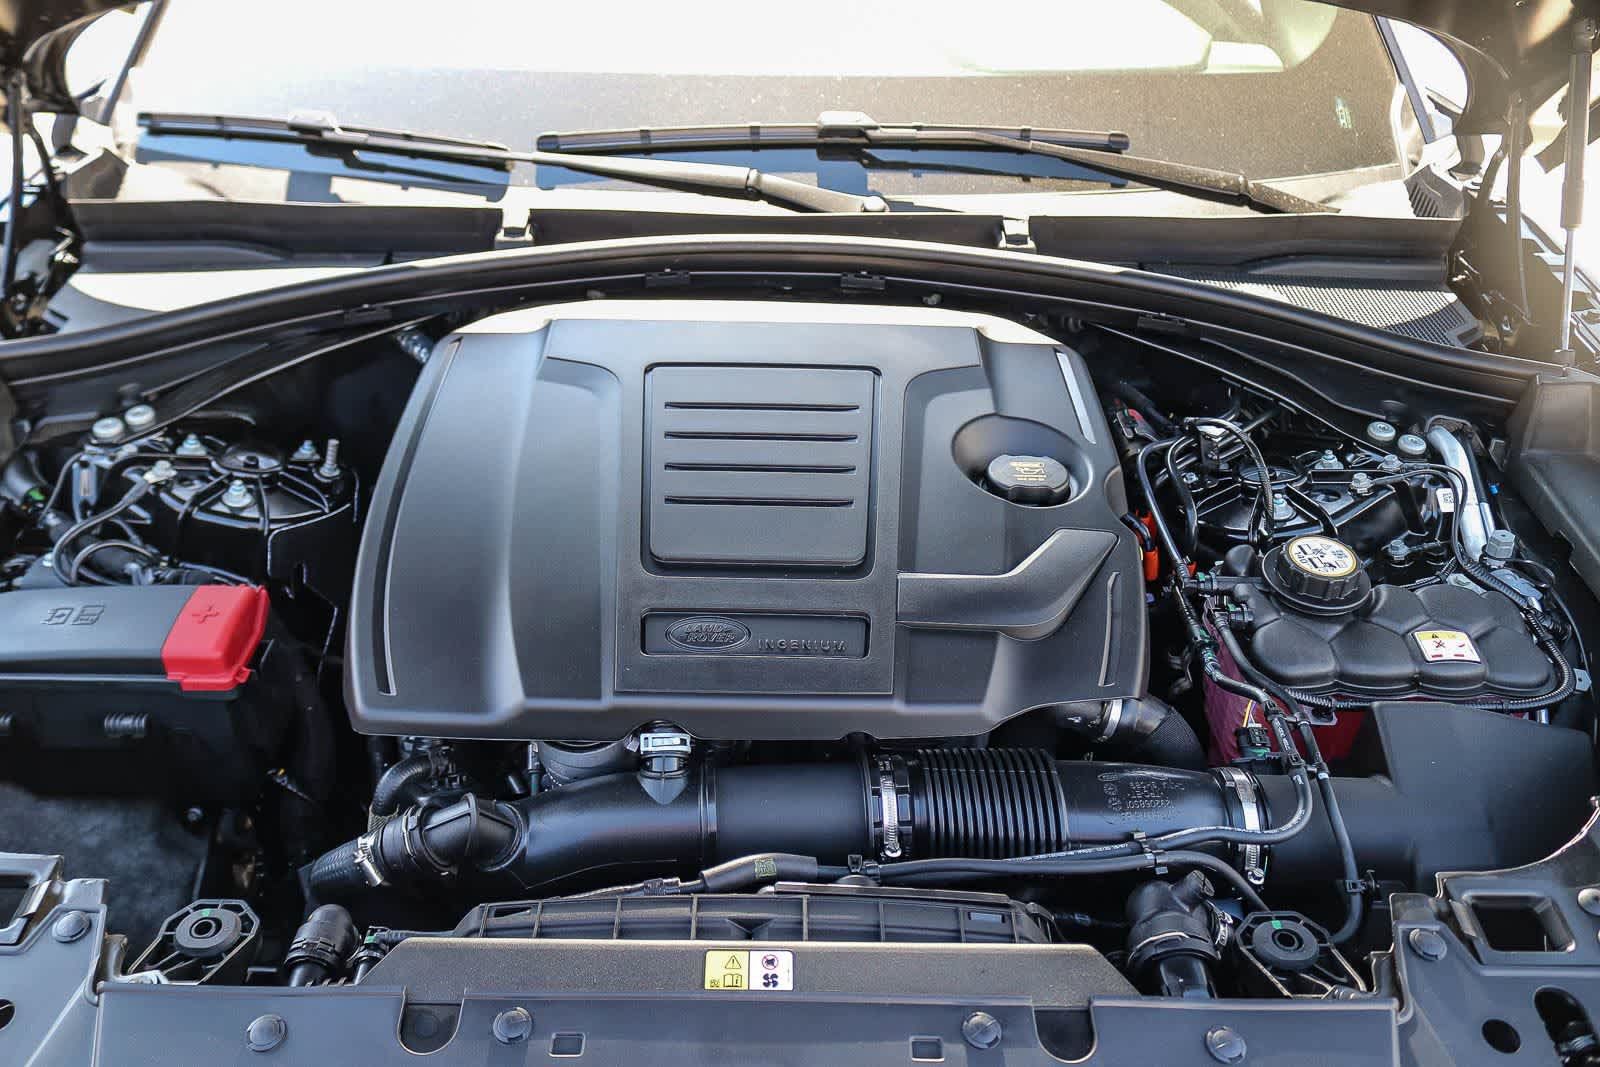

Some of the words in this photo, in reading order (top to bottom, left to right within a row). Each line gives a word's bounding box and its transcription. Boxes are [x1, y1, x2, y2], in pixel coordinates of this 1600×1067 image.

[686, 622, 727, 633] LAND
[686, 631, 737, 643] ROVER
[757, 638, 847, 653] INGENIUM
